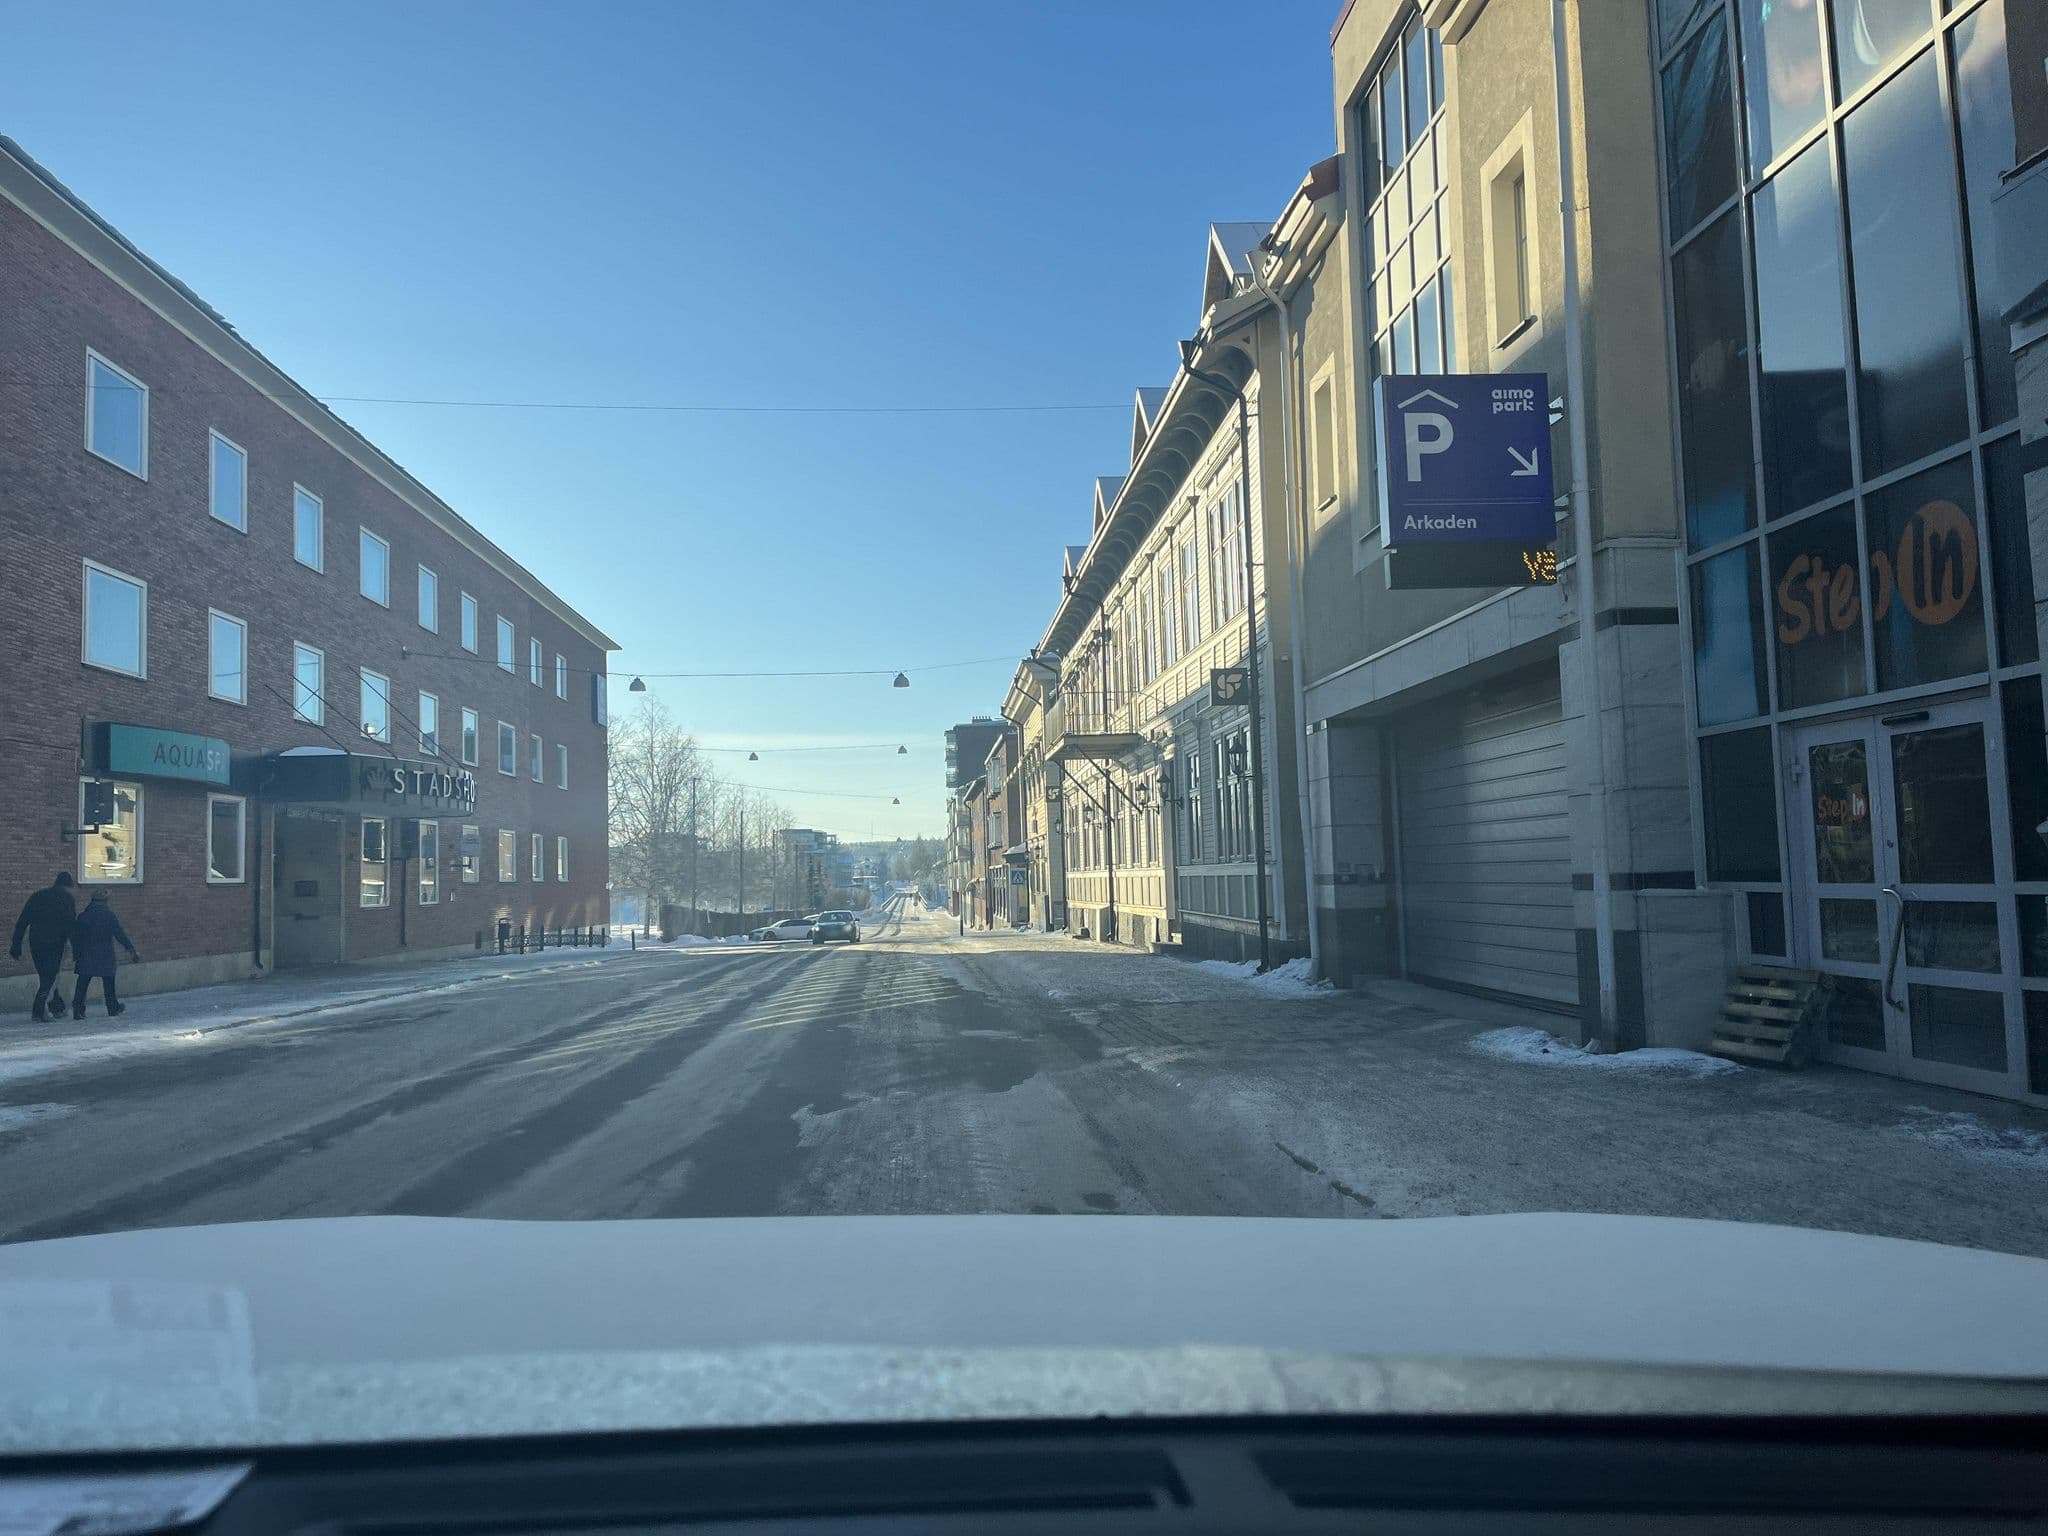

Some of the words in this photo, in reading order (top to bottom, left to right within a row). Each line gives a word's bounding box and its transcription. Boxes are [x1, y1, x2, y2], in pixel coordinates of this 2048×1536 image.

[1491, 388, 1535, 400] aimo
[1492, 399, 1535, 414] park
[1404, 412, 1454, 482] P
[1403, 514, 1478, 530] Arkaden
[153, 741, 225, 773] AQUASP
